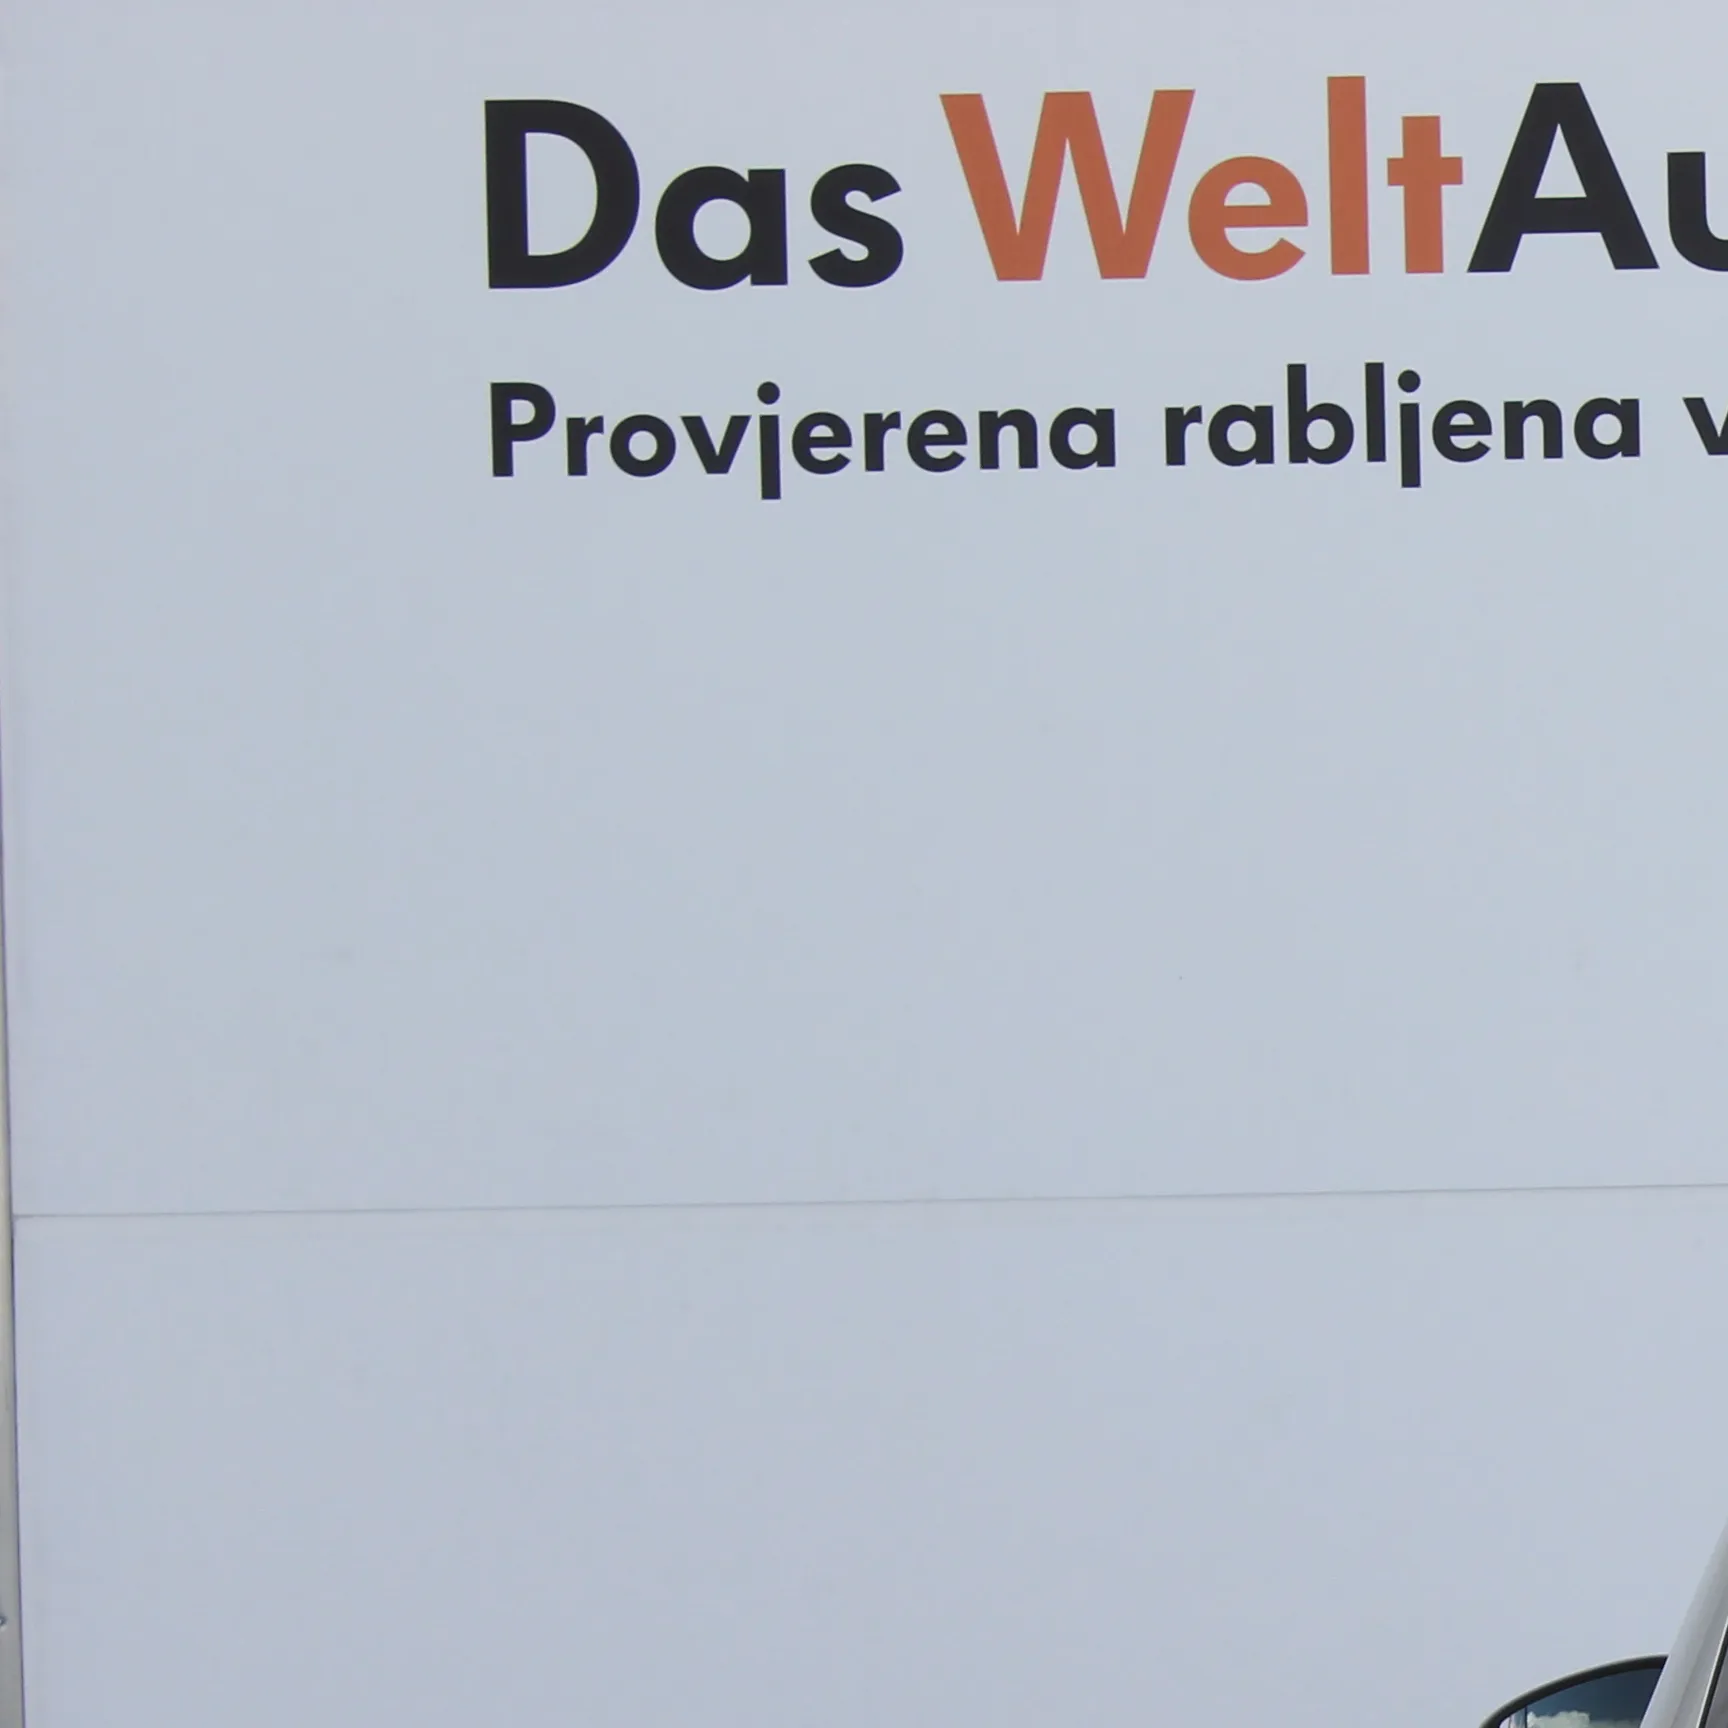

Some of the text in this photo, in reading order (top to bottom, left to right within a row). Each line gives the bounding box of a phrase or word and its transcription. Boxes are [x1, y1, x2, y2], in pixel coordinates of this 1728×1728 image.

[484, 100, 903, 290] Das
[491, 382, 1115, 500] Provjerena
[1165, 362, 1640, 488] rabljena
